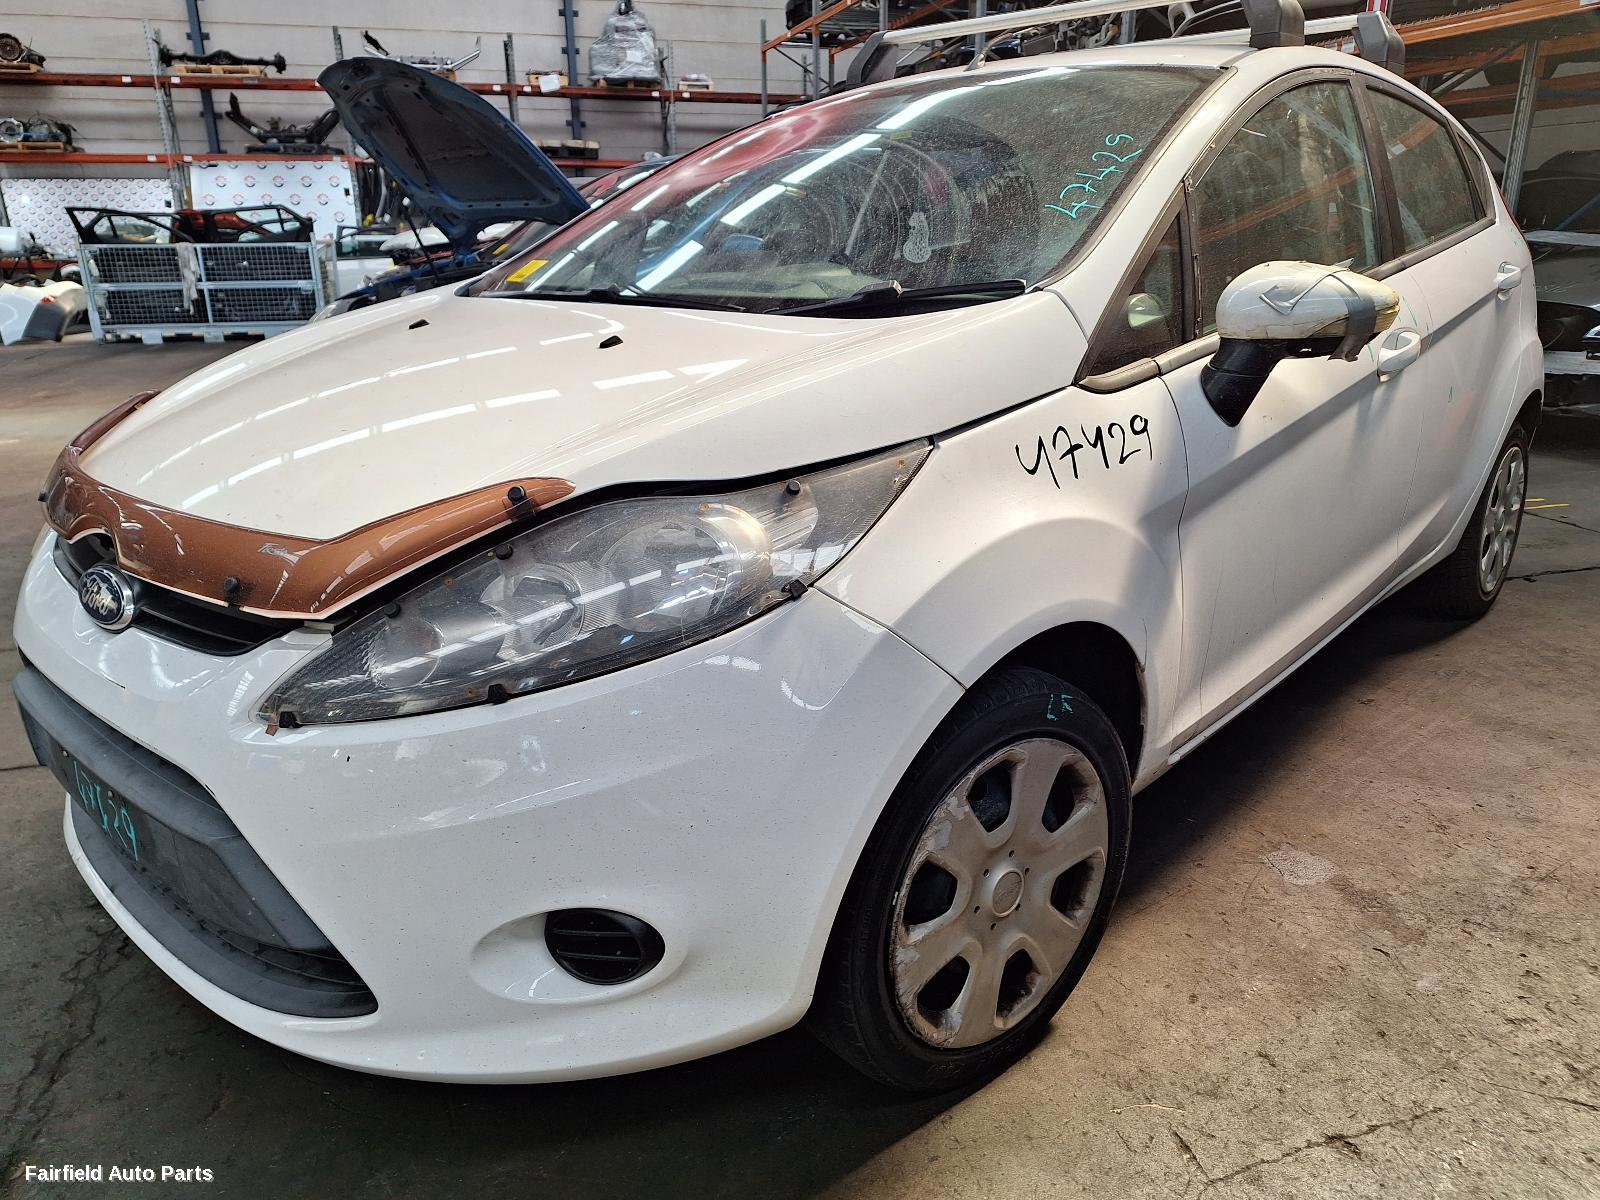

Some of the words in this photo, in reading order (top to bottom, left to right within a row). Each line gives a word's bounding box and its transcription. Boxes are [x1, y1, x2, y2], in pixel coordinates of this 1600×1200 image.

[1044, 133, 1143, 219] 47429
[1014, 414, 1153, 490] 47429
[82, 574, 119, 616] Ford
